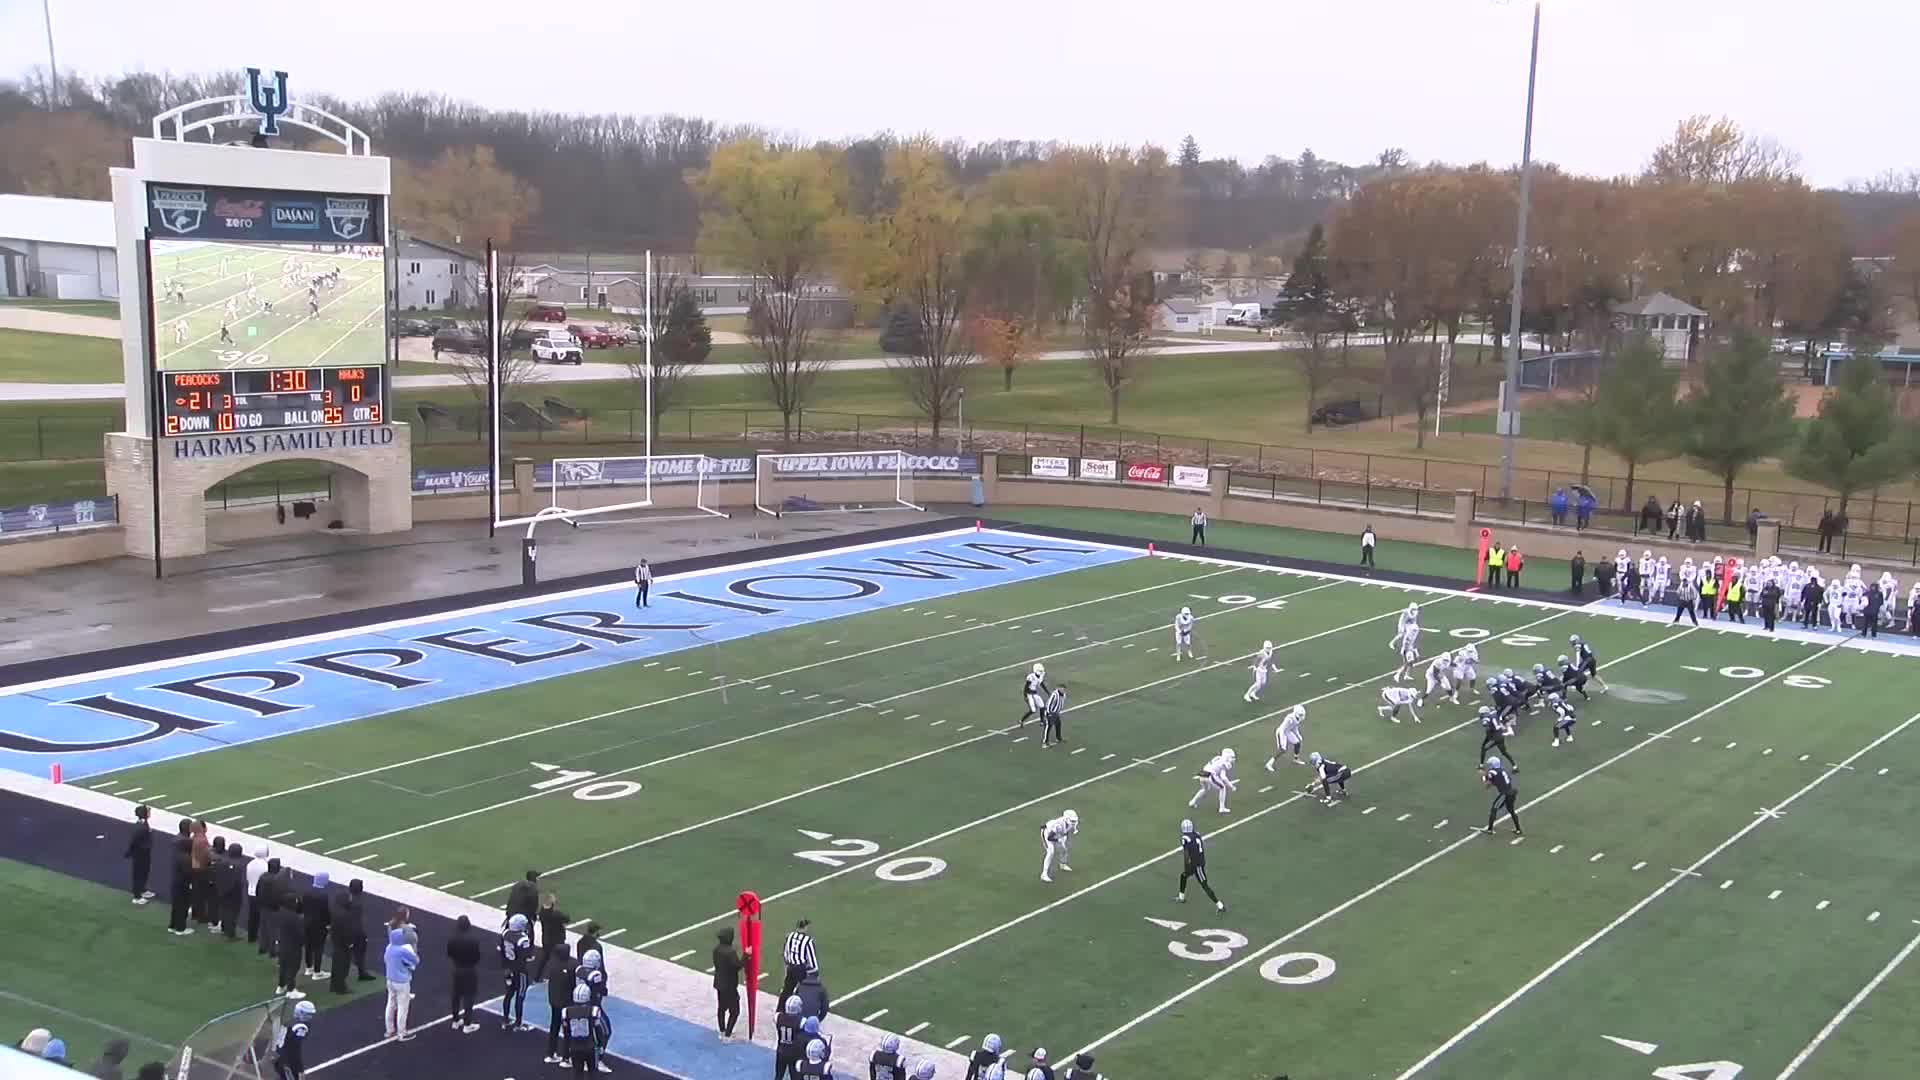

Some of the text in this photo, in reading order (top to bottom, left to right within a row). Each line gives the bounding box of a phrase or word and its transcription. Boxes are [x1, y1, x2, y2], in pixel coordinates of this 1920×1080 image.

[225, 218, 253, 228] zero
[276, 207, 314, 222] DASANI
[174, 374, 220, 386] PEACOCKS
[271, 370, 306, 391] 1:30
[190, 392, 211, 410] 21
[223, 394, 231, 408] 3
[325, 390, 332, 403] 3
[351, 385, 360, 402] 0
[284, 407, 342, 425] BALL ON 25
[353, 405, 378, 421] QTR 2
[168, 413, 262, 433] 2 DOWN 10 TO GO
[175, 427, 393, 458] HARMS FAMILY FIELD
[647, 458, 752, 475] HOME OF THE
[777, 455, 960, 471] UPPER IOWA PEACOCKS
[1086, 463, 1109, 471] Scott
[0, 541, 1103, 755] UPPER IOWA
[793, 838, 948, 882] 20
[1166, 928, 1337, 985] 30
[780, 1026, 793, 1045] 11
